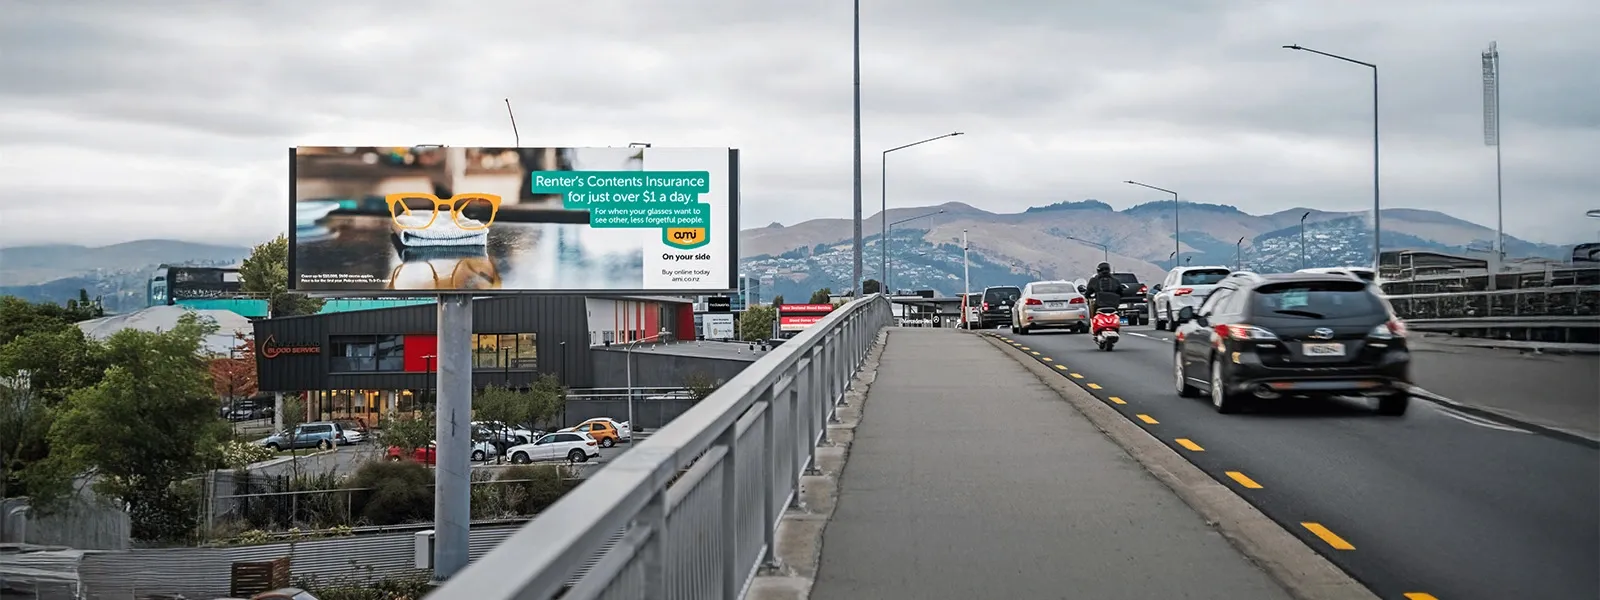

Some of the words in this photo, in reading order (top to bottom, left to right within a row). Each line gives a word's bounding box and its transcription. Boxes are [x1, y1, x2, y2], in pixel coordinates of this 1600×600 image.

[536, 176, 584, 187] Renter's
[587, 176, 642, 187] Contents
[646, 176, 704, 186] Insurance
[568, 191, 586, 202] for
[587, 191, 610, 204] just
[613, 193, 640, 202] over
[642, 190, 656, 203] $1
[659, 193, 666, 202] a
[670, 192, 693, 204] day.
[647, 208, 672, 216] glasses
[674, 230, 696, 239] ami
